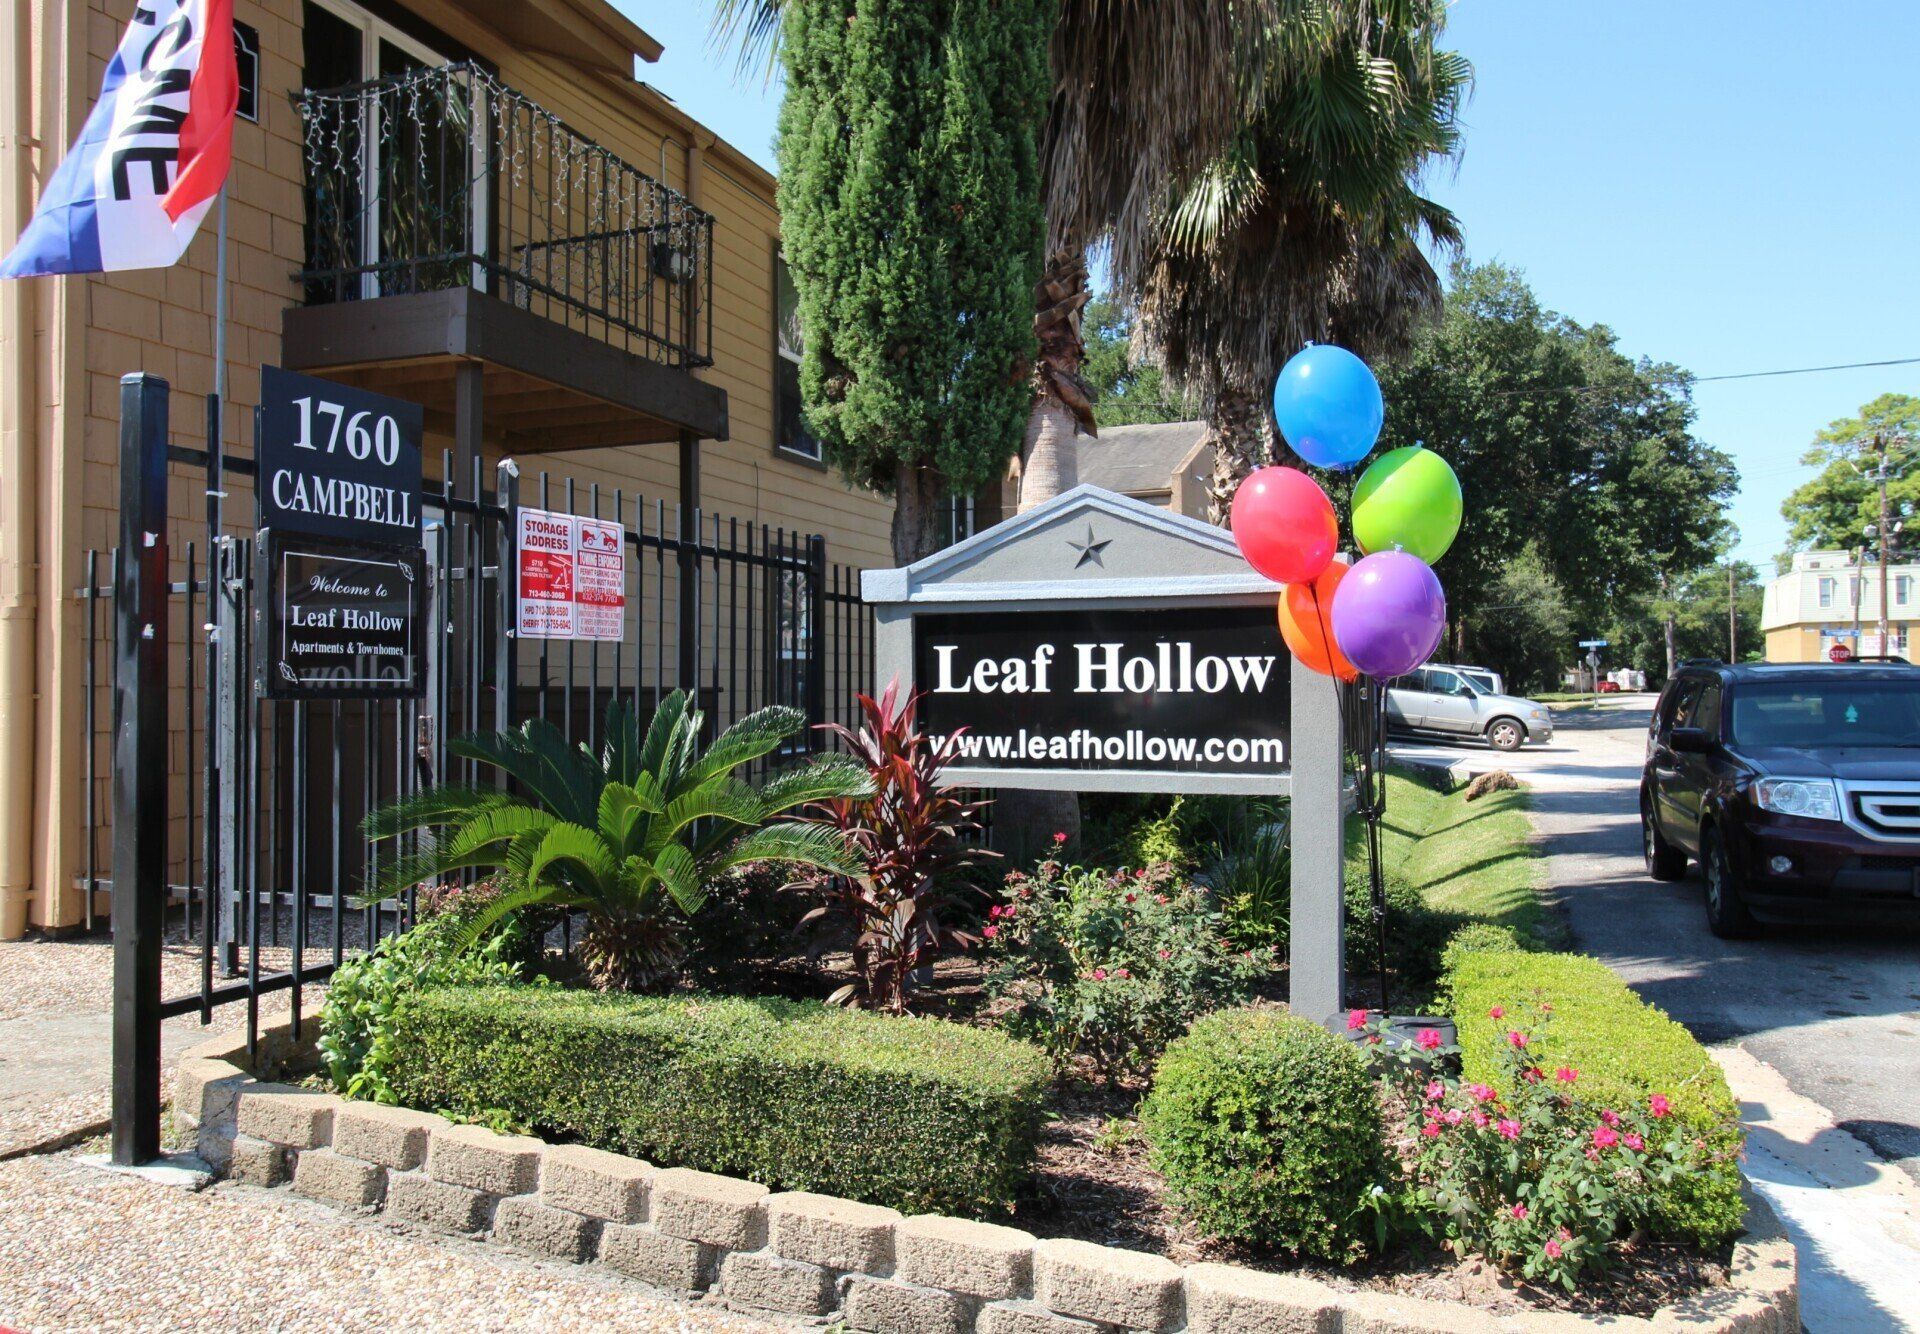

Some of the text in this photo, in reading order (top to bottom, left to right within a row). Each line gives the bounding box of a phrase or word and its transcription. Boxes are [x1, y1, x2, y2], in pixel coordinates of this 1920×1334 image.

[292, 396, 400, 466] 1760
[272, 469, 416, 528] CAMPBELL
[525, 519, 569, 537] STORAGE
[525, 535, 569, 550] ADDRESS
[309, 574, 388, 597] Welcome to
[291, 605, 404, 632] Leaf Hollow
[291, 640, 404, 656] Apartments & Townhomes
[1830, 650, 1850, 659] STOP
[933, 641, 1276, 693] Leaf Hollow
[929, 728, 1284, 763] www.leafhollow.com
